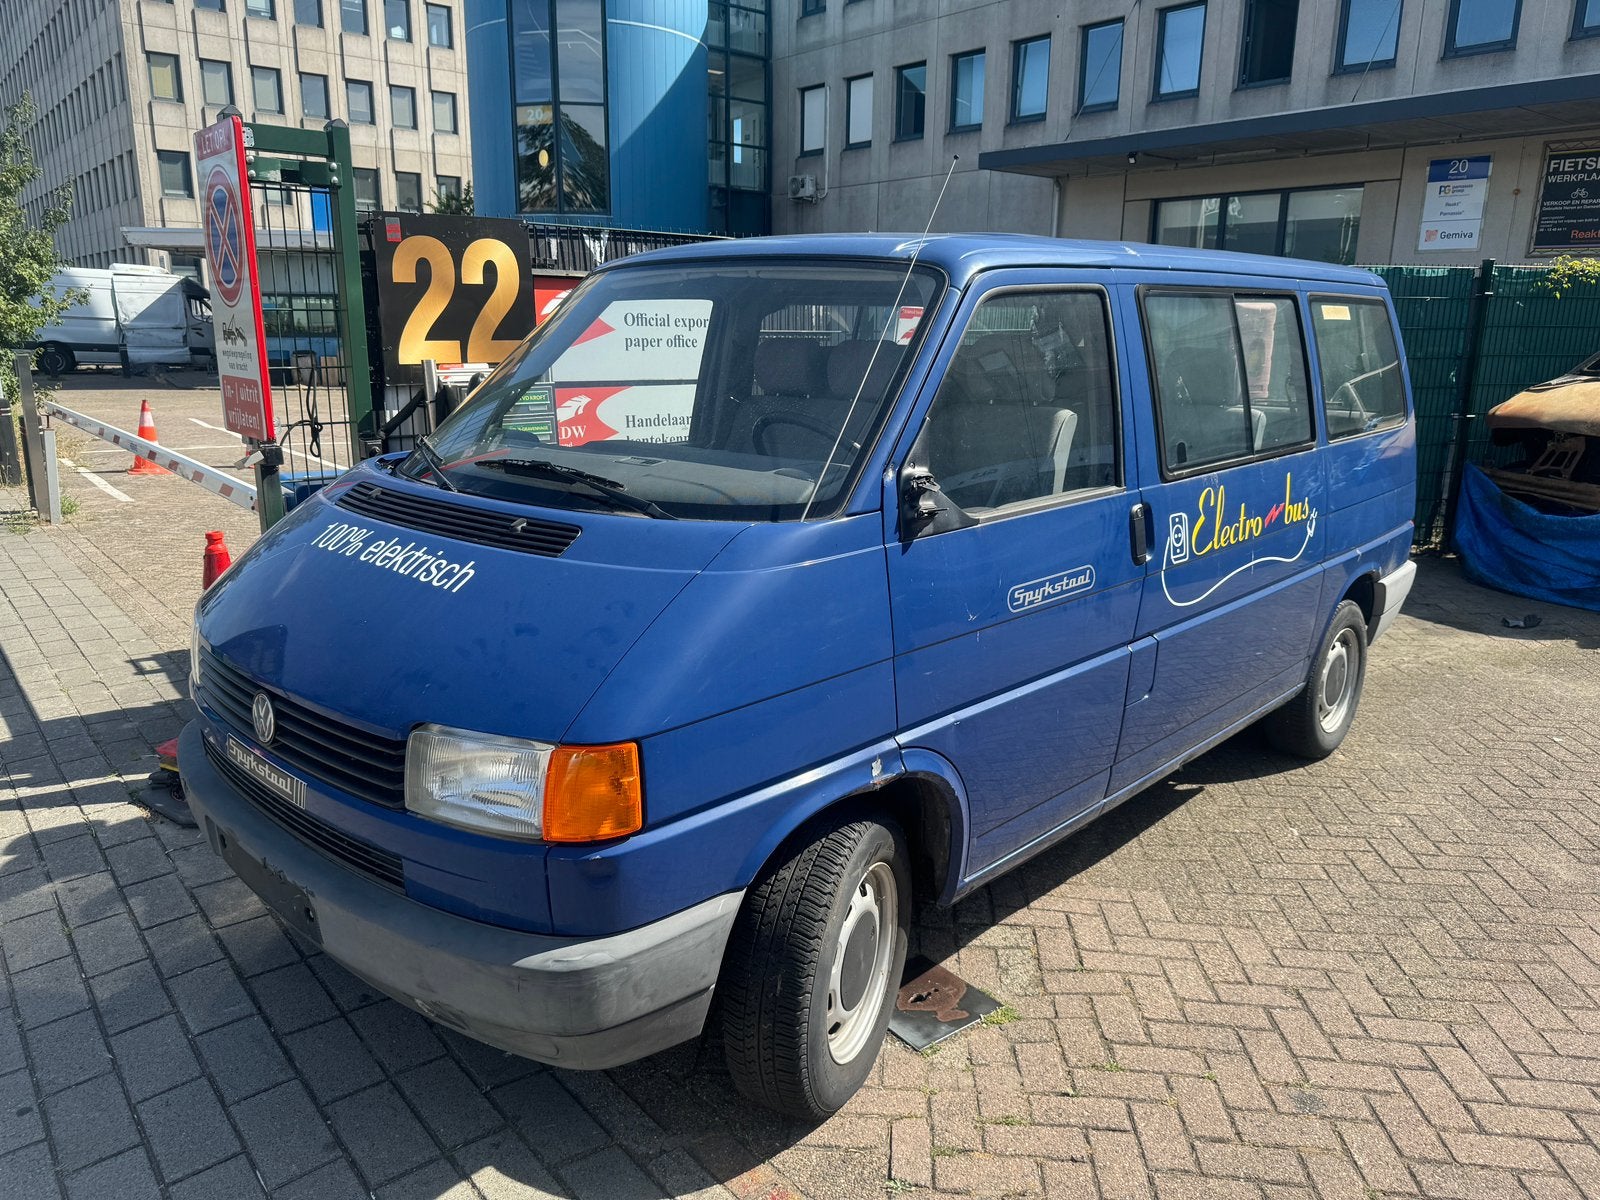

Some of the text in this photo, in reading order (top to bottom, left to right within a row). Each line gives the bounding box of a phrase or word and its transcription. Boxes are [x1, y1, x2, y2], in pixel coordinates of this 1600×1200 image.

[527, 109, 544, 121] 20
[201, 133, 214, 155] LET
[1449, 159, 1469, 174] 20
[1440, 230, 1474, 240] Gemiva
[392, 234, 523, 364] 22
[623, 312, 670, 327] Official
[625, 335, 698, 351] paper office
[240, 383, 259, 403] uitrit
[228, 407, 260, 430] vrijlaten!
[559, 425, 587, 439] DW
[1191, 472, 1309, 556] Electro bus
[311, 522, 477, 593] 100% elektrisch
[1012, 569, 1092, 607] Spykstaal
[228, 738, 293, 795] Spykstaal
